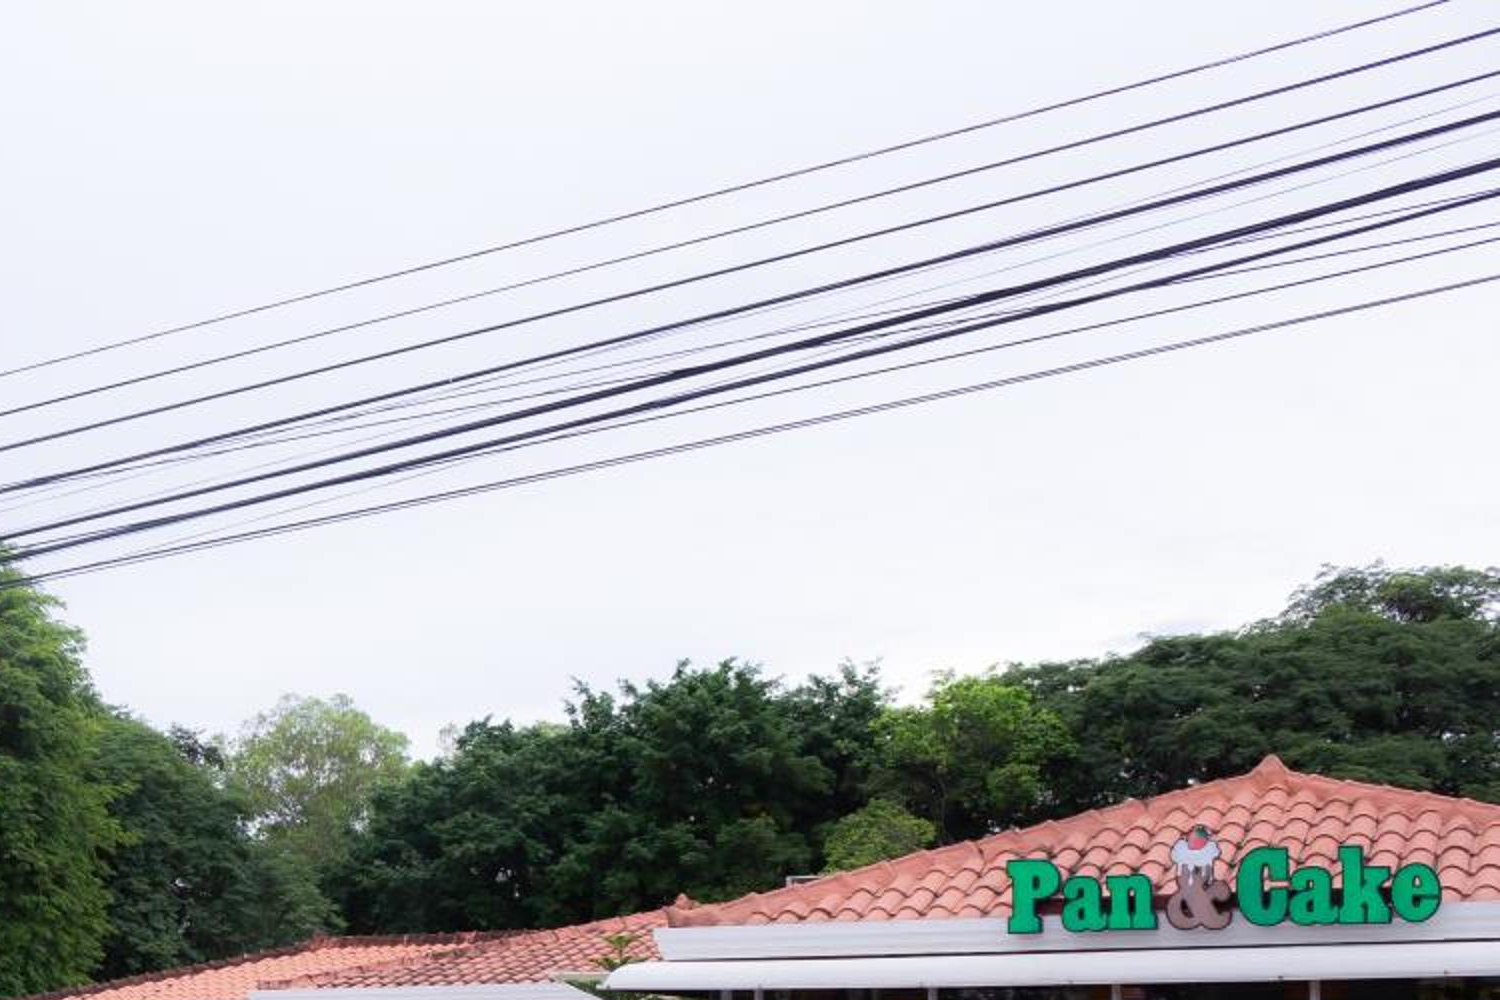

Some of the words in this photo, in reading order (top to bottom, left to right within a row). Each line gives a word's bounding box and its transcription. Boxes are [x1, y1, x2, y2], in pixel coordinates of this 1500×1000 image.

[1006, 858, 1159, 935] Pan
[1166, 857, 1233, 931] &
[1235, 844, 1443, 927] Cake
